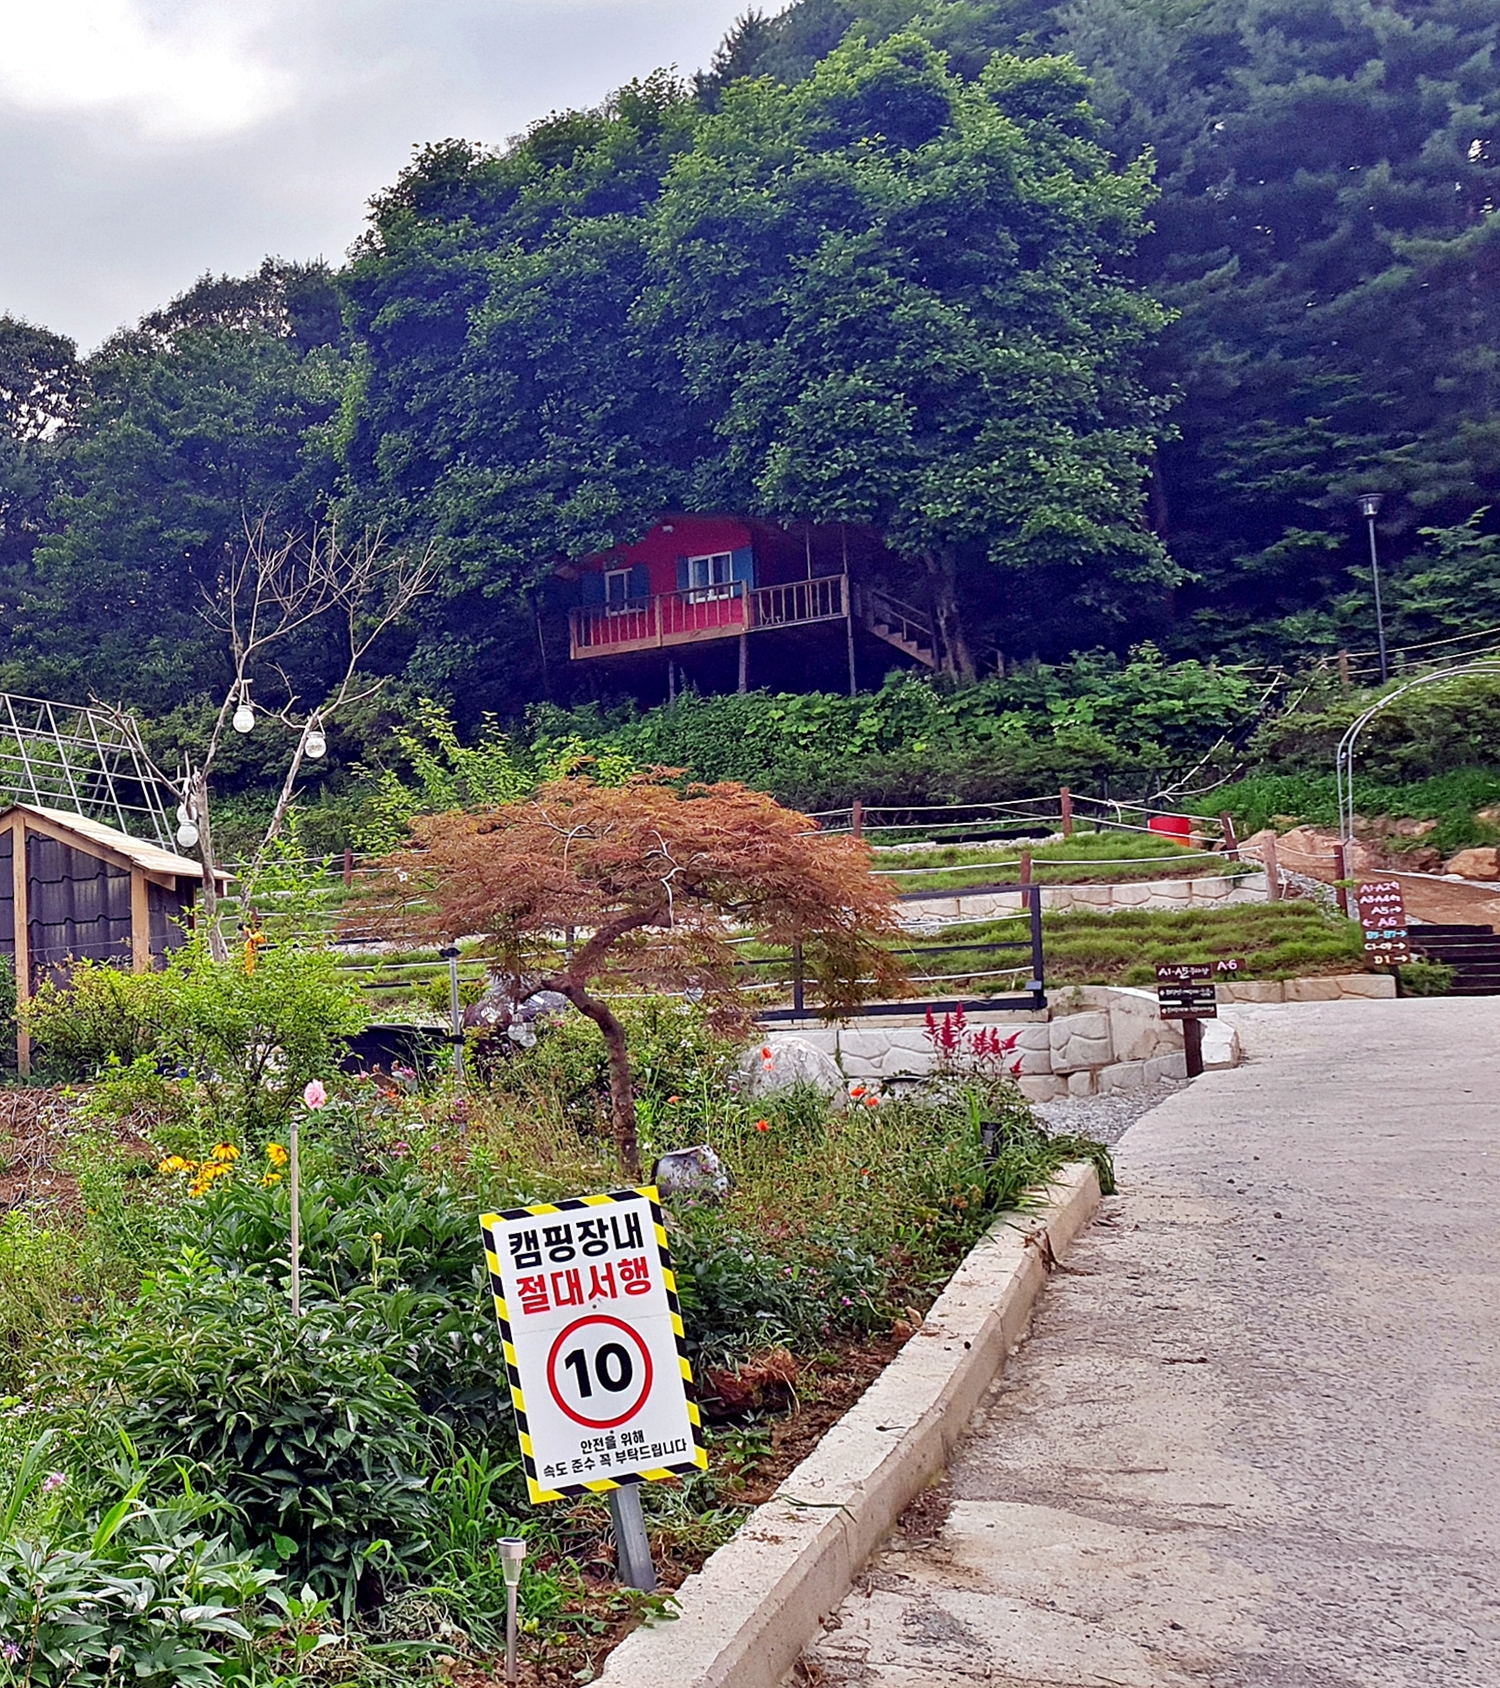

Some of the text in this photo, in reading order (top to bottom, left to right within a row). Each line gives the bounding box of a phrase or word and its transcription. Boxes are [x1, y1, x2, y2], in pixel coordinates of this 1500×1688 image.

[1378, 917, 1397, 927] A6
[508, 1212, 644, 1270] 캠핑장내
[516, 1257, 651, 1315] 절대서행
[564, 1343, 633, 1398] 10
[543, 1438, 687, 1478] 속도 준수 꼭 부탁드립니다
[580, 1429, 645, 1454] 안전을 위해
